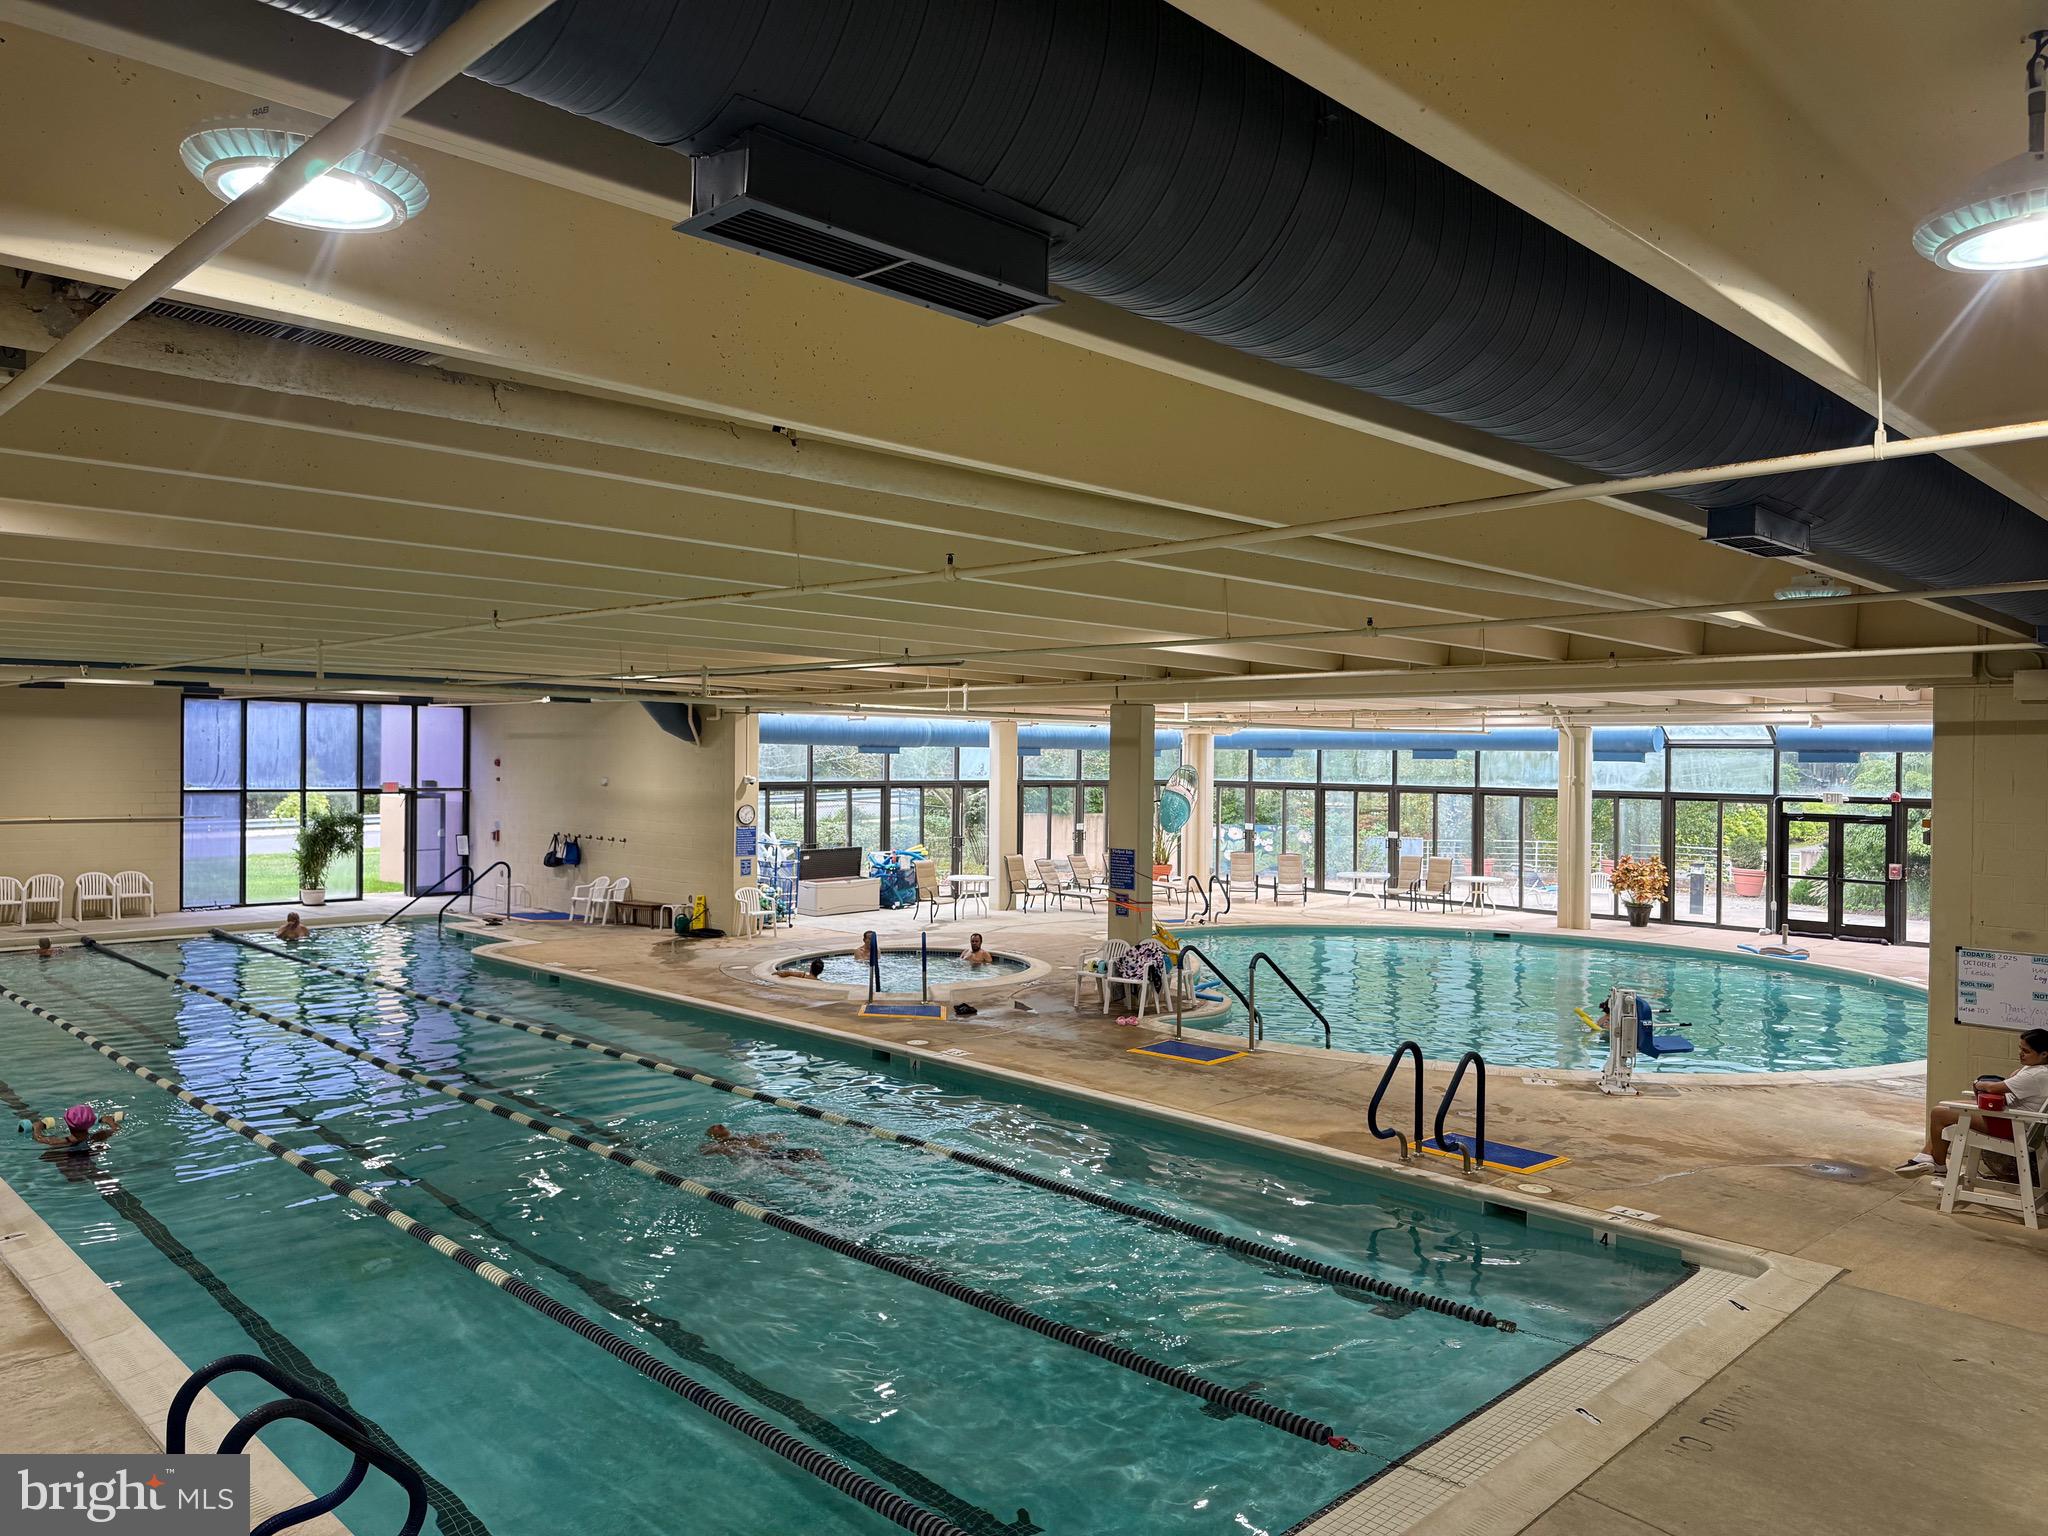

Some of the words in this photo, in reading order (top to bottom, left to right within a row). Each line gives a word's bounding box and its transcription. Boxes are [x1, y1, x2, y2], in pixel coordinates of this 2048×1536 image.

[252, 105, 270, 117] RAB
[1963, 960, 1997, 969] OCTOBER
[1599, 1232, 1609, 1247] 4
[1728, 1299, 1750, 1311] 4
